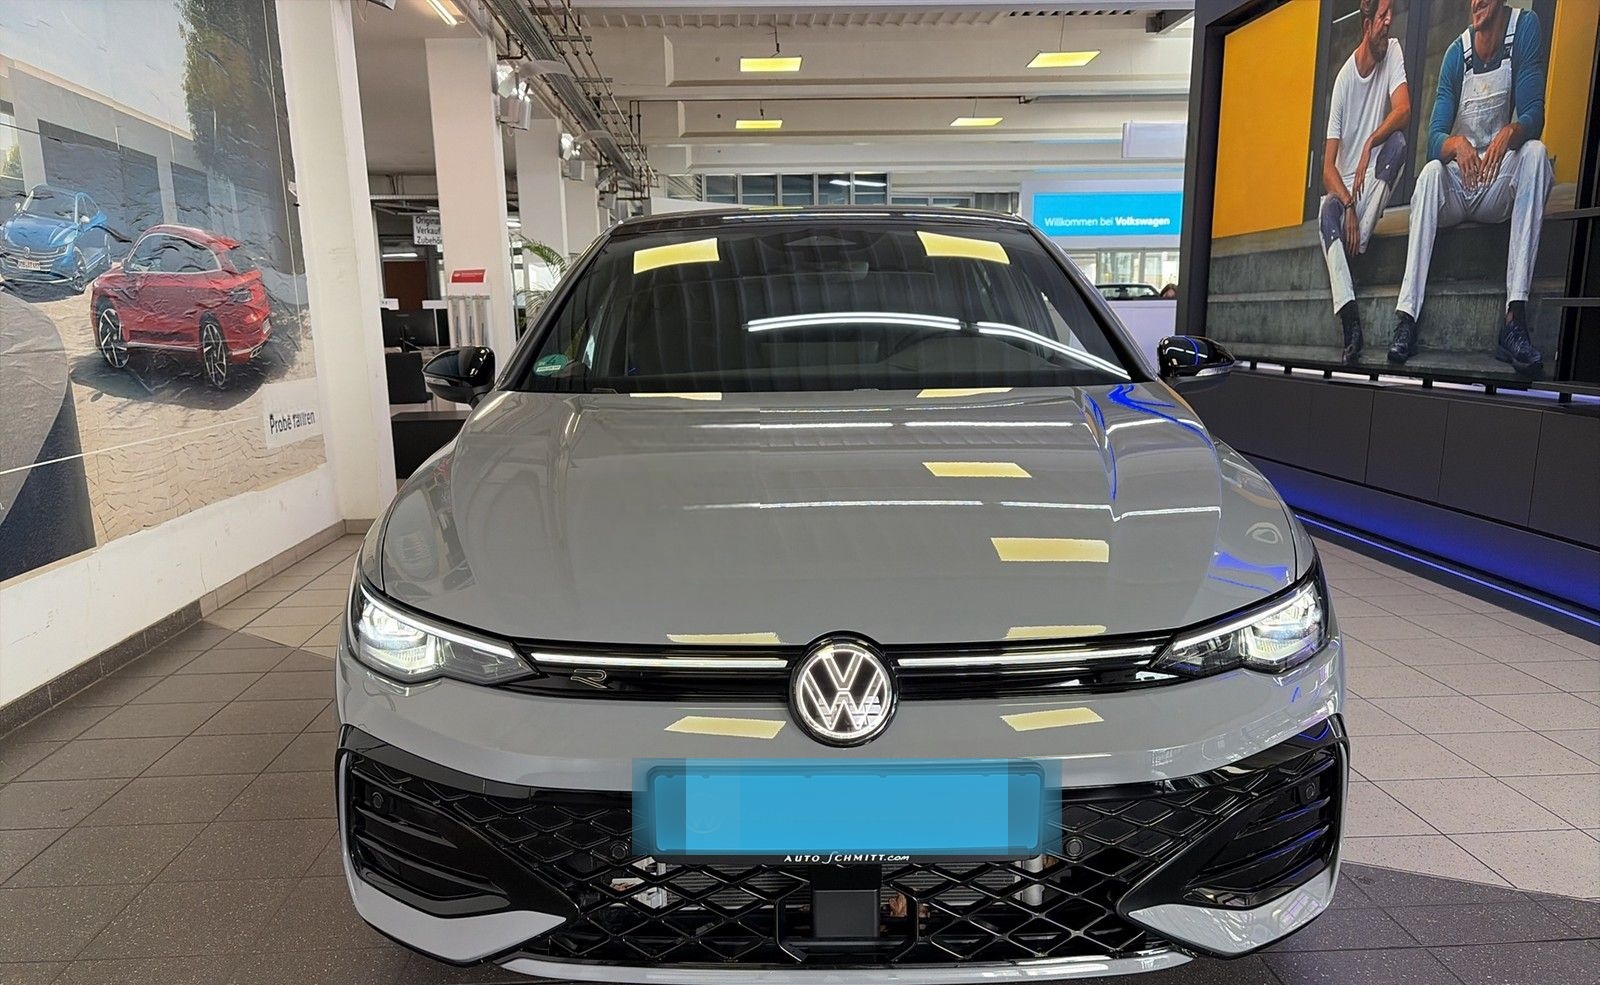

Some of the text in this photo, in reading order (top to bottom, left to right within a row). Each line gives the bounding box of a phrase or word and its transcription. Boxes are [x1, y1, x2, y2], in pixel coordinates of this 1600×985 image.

[1044, 216, 1170, 228] Willkommen bei Volkswagen
[269, 414, 292, 434] Probe
[783, 854, 820, 863] AUTO
